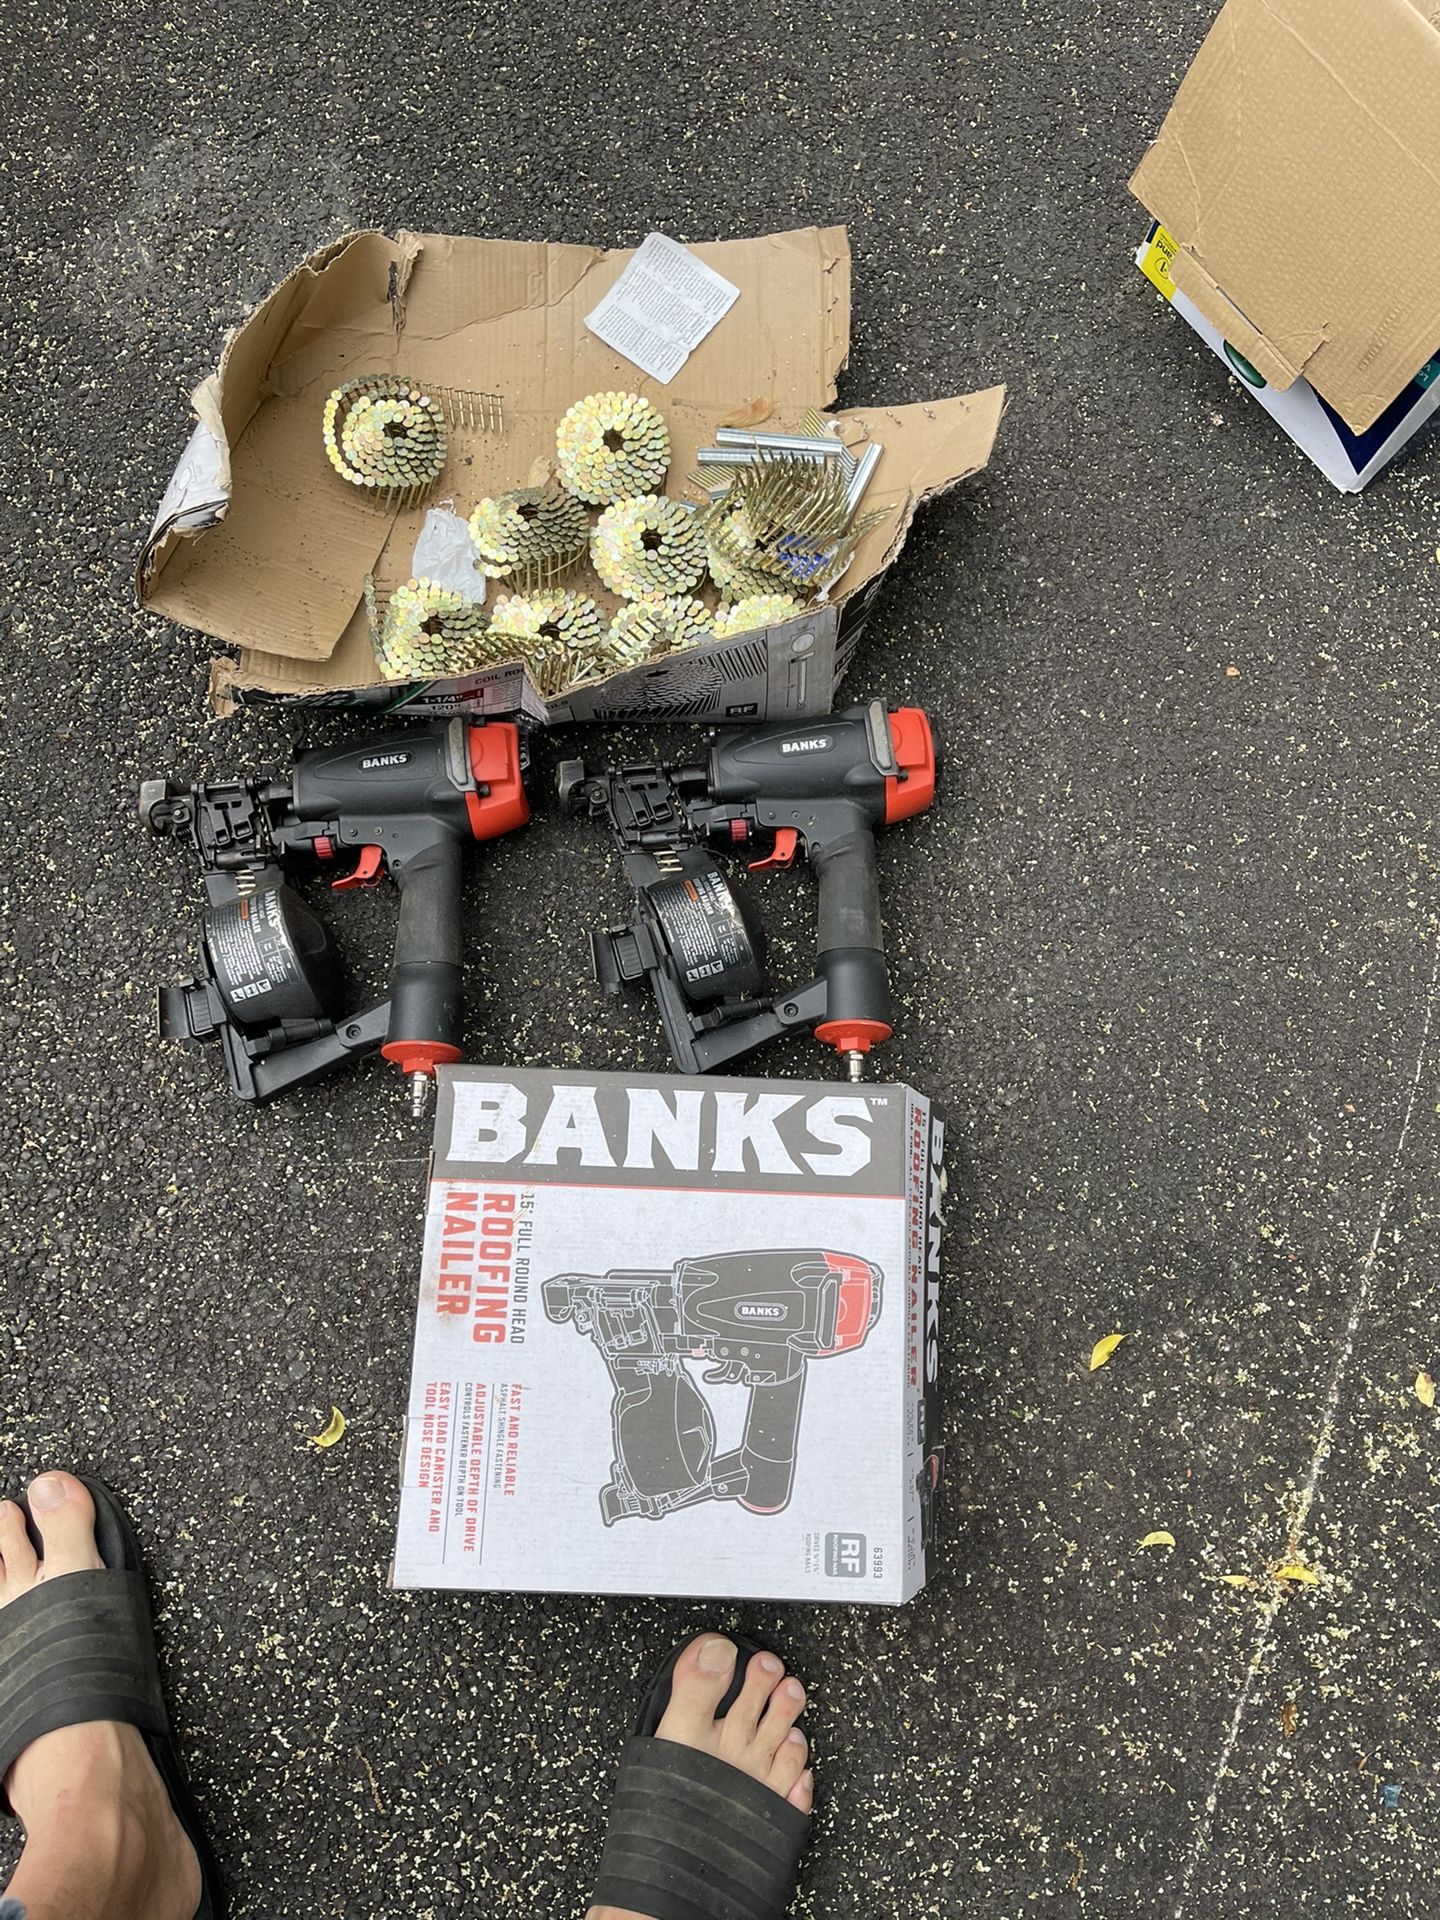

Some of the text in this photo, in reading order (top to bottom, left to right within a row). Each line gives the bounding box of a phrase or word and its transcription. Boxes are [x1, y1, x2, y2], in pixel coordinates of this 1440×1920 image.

[475, 674, 501, 685] COIL
[362, 754, 408, 769] BANKS
[782, 739, 827, 754] BANKS
[445, 1081, 874, 1177] BANKS
[436, 1192, 479, 1315] NAILER
[472, 1193, 516, 1344] ROOFING
[513, 1257, 530, 1303] ROUND
[516, 1220, 533, 1252] FULL
[910, 1106, 922, 1386] ROOFING NAILER
[926, 1116, 945, 1383] BANKS
[510, 1308, 527, 1344] HEAD
[741, 1306, 780, 1316] BANKS
[418, 1382, 437, 1488] TOOL NOSE DESIGN
[429, 1382, 451, 1532] EASY LOAD CANISTER AND
[455, 1382, 473, 1517] CONTROLS FASTENER DEPTH ON TOOL
[463, 1383, 486, 1552] ADJUSTABLE DEPTH OF DRIVE
[493, 1383, 508, 1489] ASPHALT SHINGLE FASTENING
[503, 1383, 522, 1496] FAST AND RELIABLE
[841, 1539, 860, 1574] RF
[873, 1547, 883, 1579] 63993
